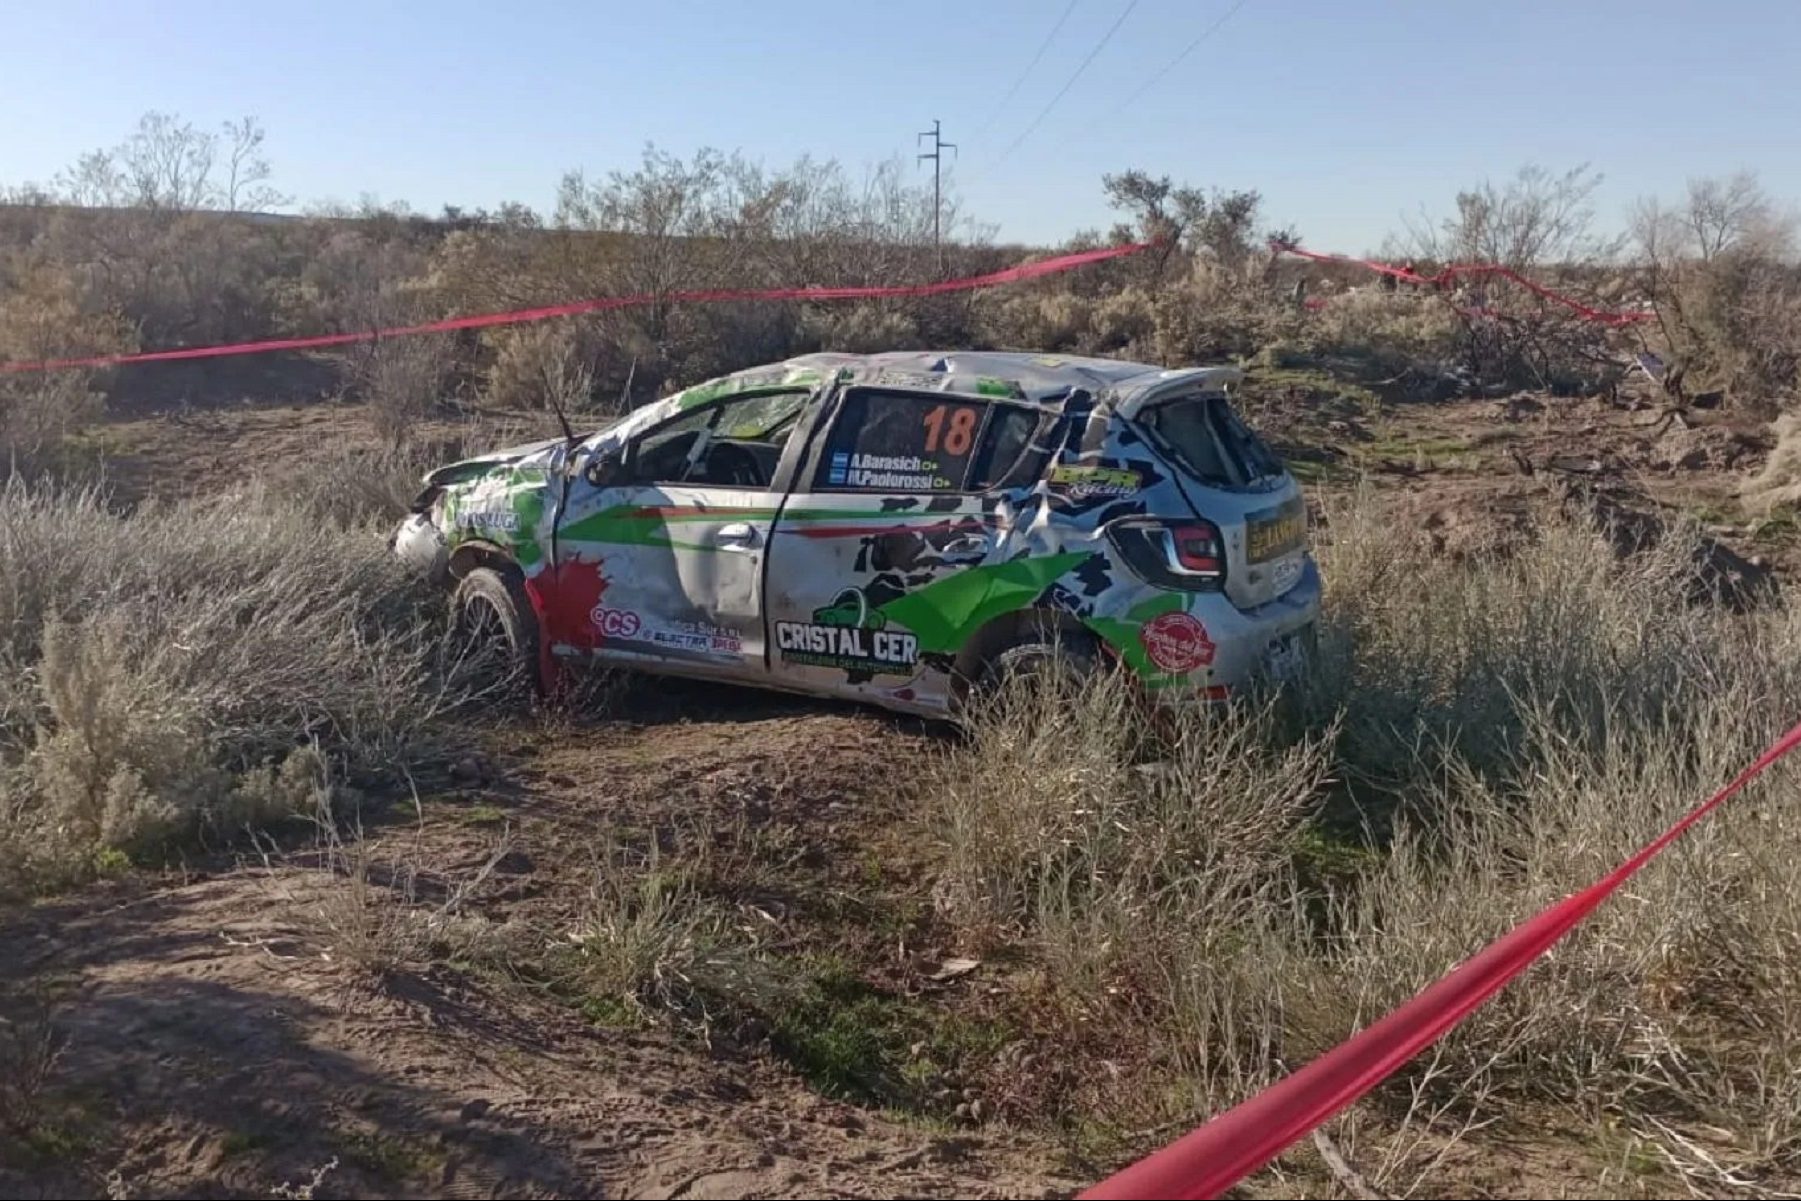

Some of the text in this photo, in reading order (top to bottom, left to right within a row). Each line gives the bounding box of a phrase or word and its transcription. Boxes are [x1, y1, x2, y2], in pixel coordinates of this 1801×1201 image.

[923, 405, 977, 456] 18
[850, 453, 921, 471] A.Barasich
[776, 622, 868, 657] CRISTAL
[873, 632, 917, 664] CER
